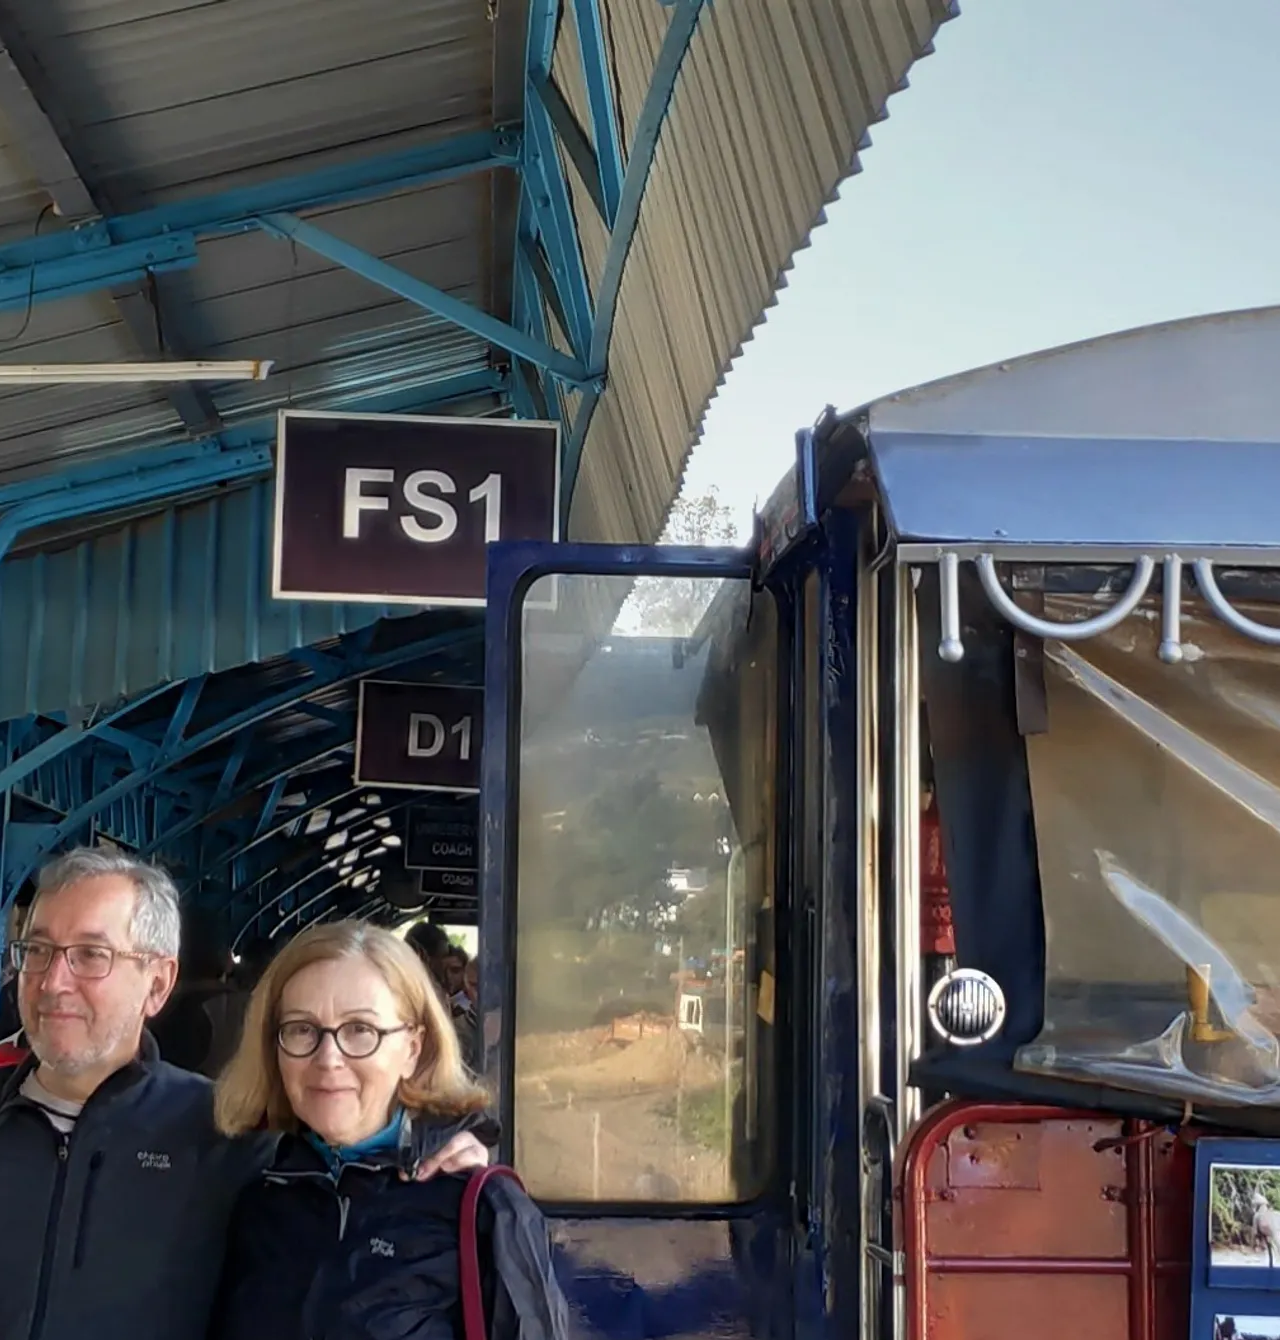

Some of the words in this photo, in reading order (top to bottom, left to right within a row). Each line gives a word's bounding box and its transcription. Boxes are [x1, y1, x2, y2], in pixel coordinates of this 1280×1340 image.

[342, 467, 502, 543] FS1
[407, 712, 472, 761] D1
[431, 841, 473, 857] COACH
[441, 873, 475, 886] COACH
